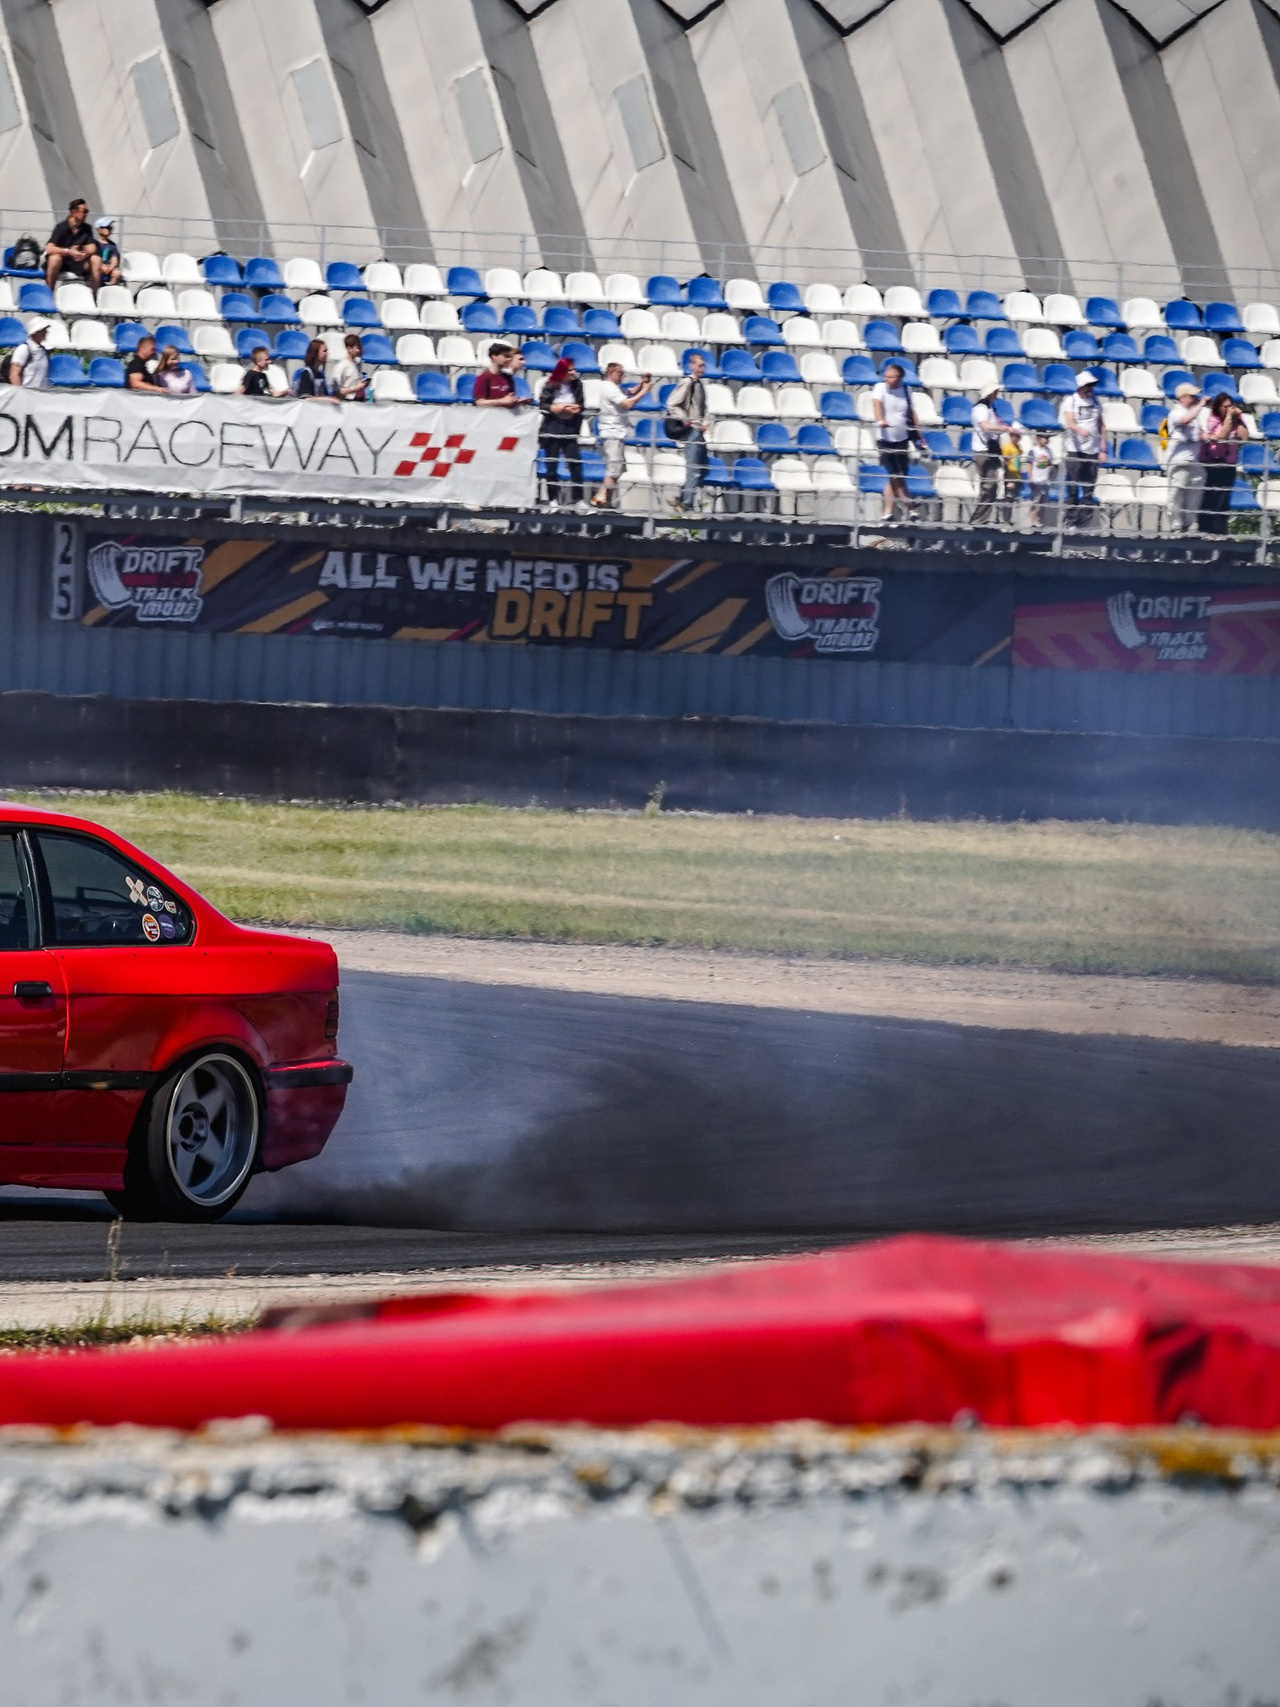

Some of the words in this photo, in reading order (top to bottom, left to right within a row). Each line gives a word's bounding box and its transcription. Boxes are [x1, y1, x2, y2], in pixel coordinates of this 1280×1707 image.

[122, 551, 200, 574] DRIFT
[318, 550, 403, 590] ALL
[407, 555, 479, 592] WE
[485, 558, 580, 596] NEED
[587, 561, 621, 593] IS
[801, 582, 878, 605] DRIFT
[491, 588, 654, 640] DRIFT
[1137, 595, 1212, 619] DRIFT
